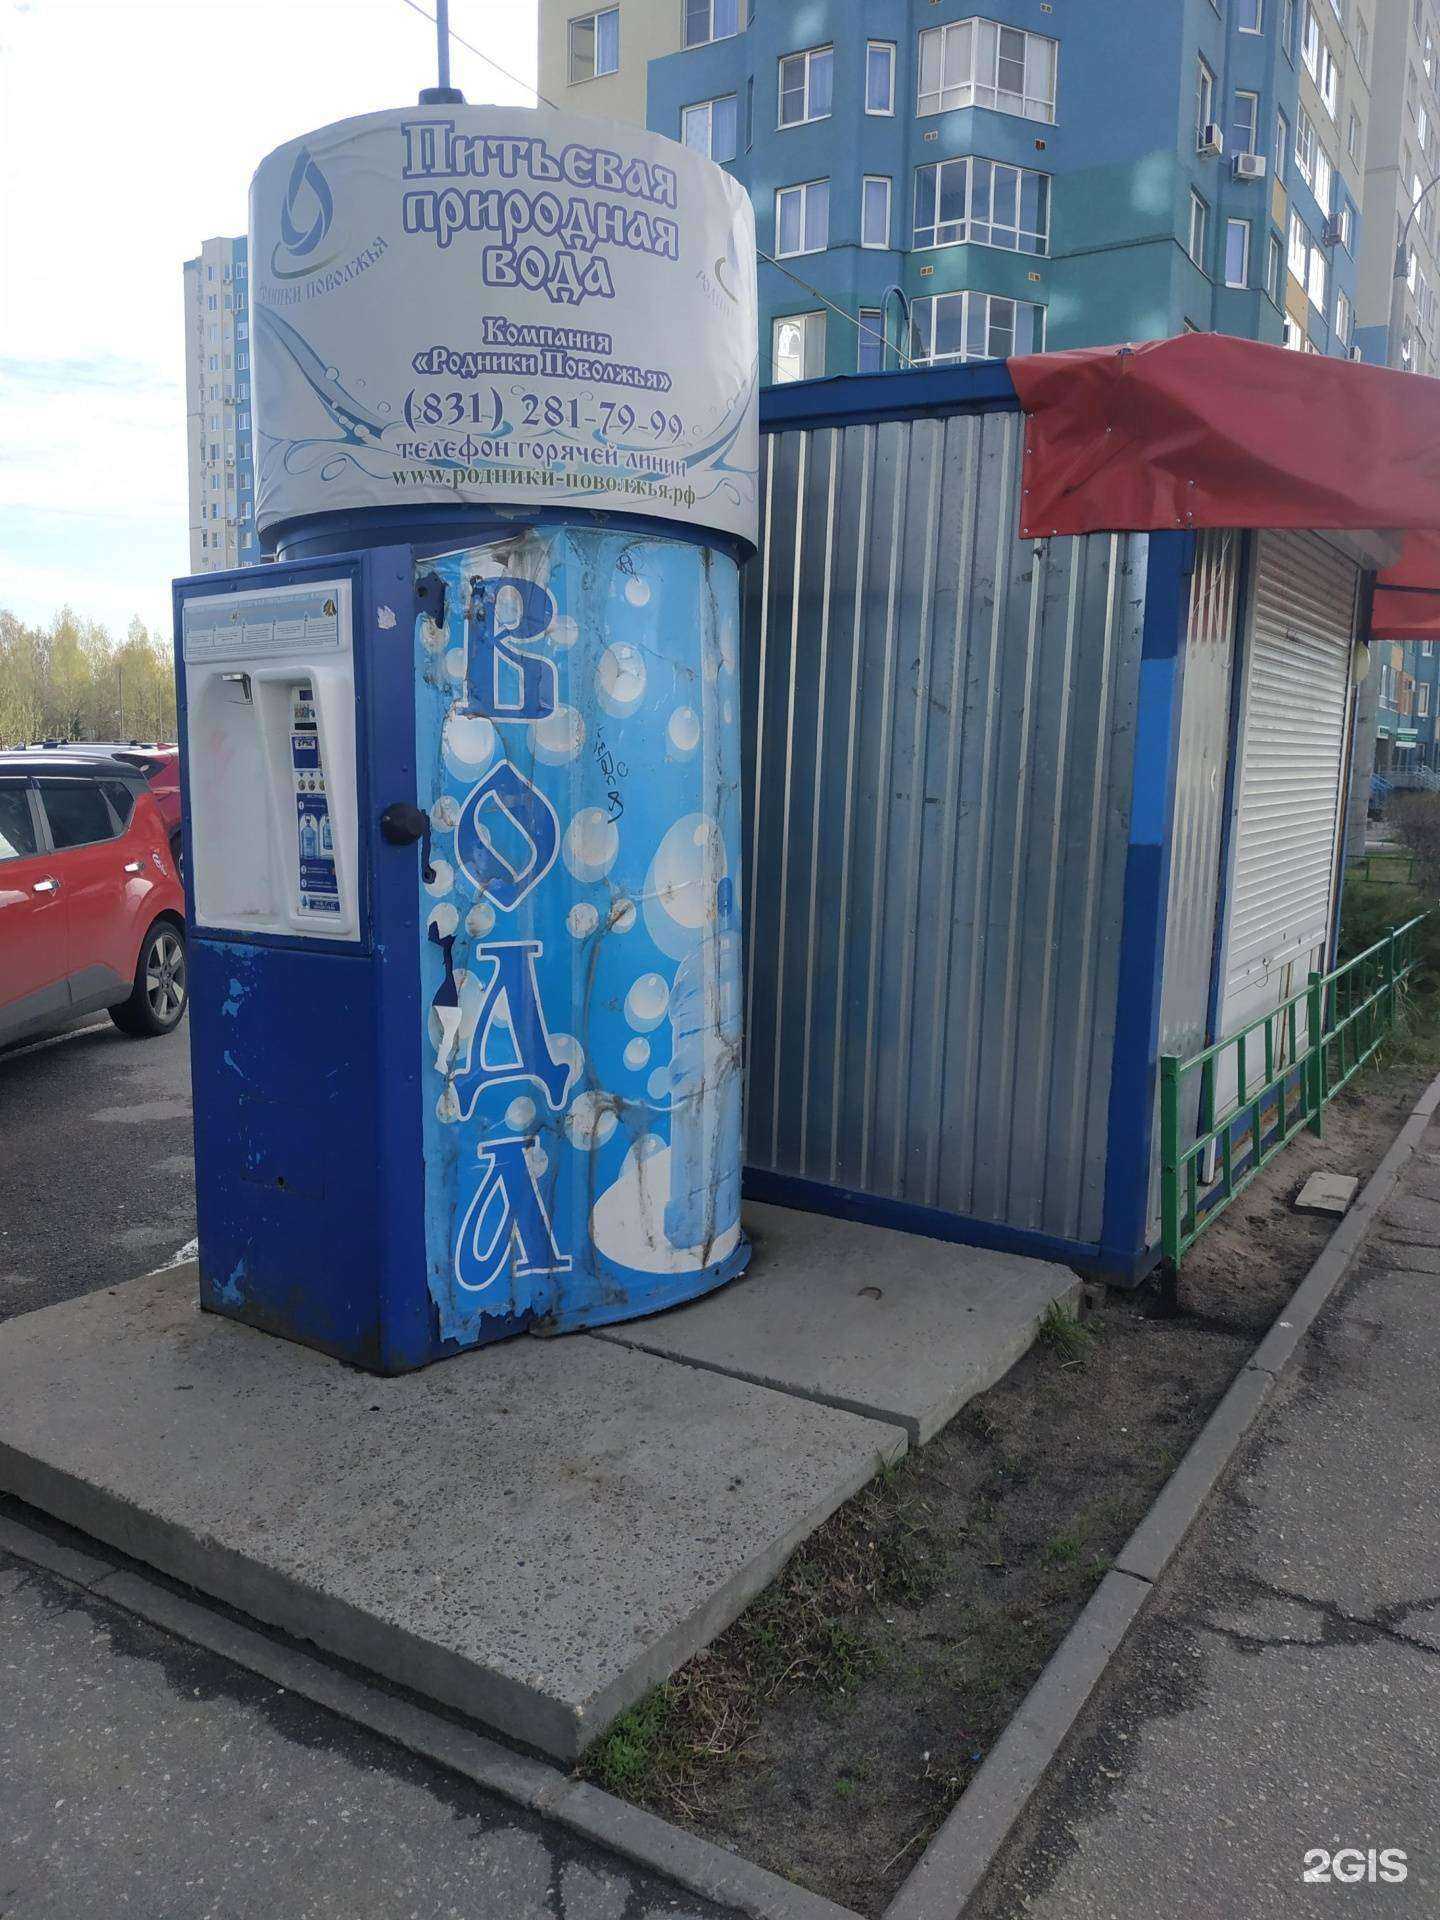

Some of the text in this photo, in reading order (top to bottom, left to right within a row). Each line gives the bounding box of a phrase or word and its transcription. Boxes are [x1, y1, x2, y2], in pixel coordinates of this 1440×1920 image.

[401, 119, 678, 208] Питьевая
[402, 188, 679, 261] природная
[481, 245, 616, 306] вода
[481, 316, 613, 355] Компания
[411, 345, 673, 393] «Родники Поволжья»
[403, 387, 684, 444] (831) 281-79-99
[395, 433, 688, 478] телефон горячей линии
[391, 466, 697, 509] www.родники-поволжья.рф
